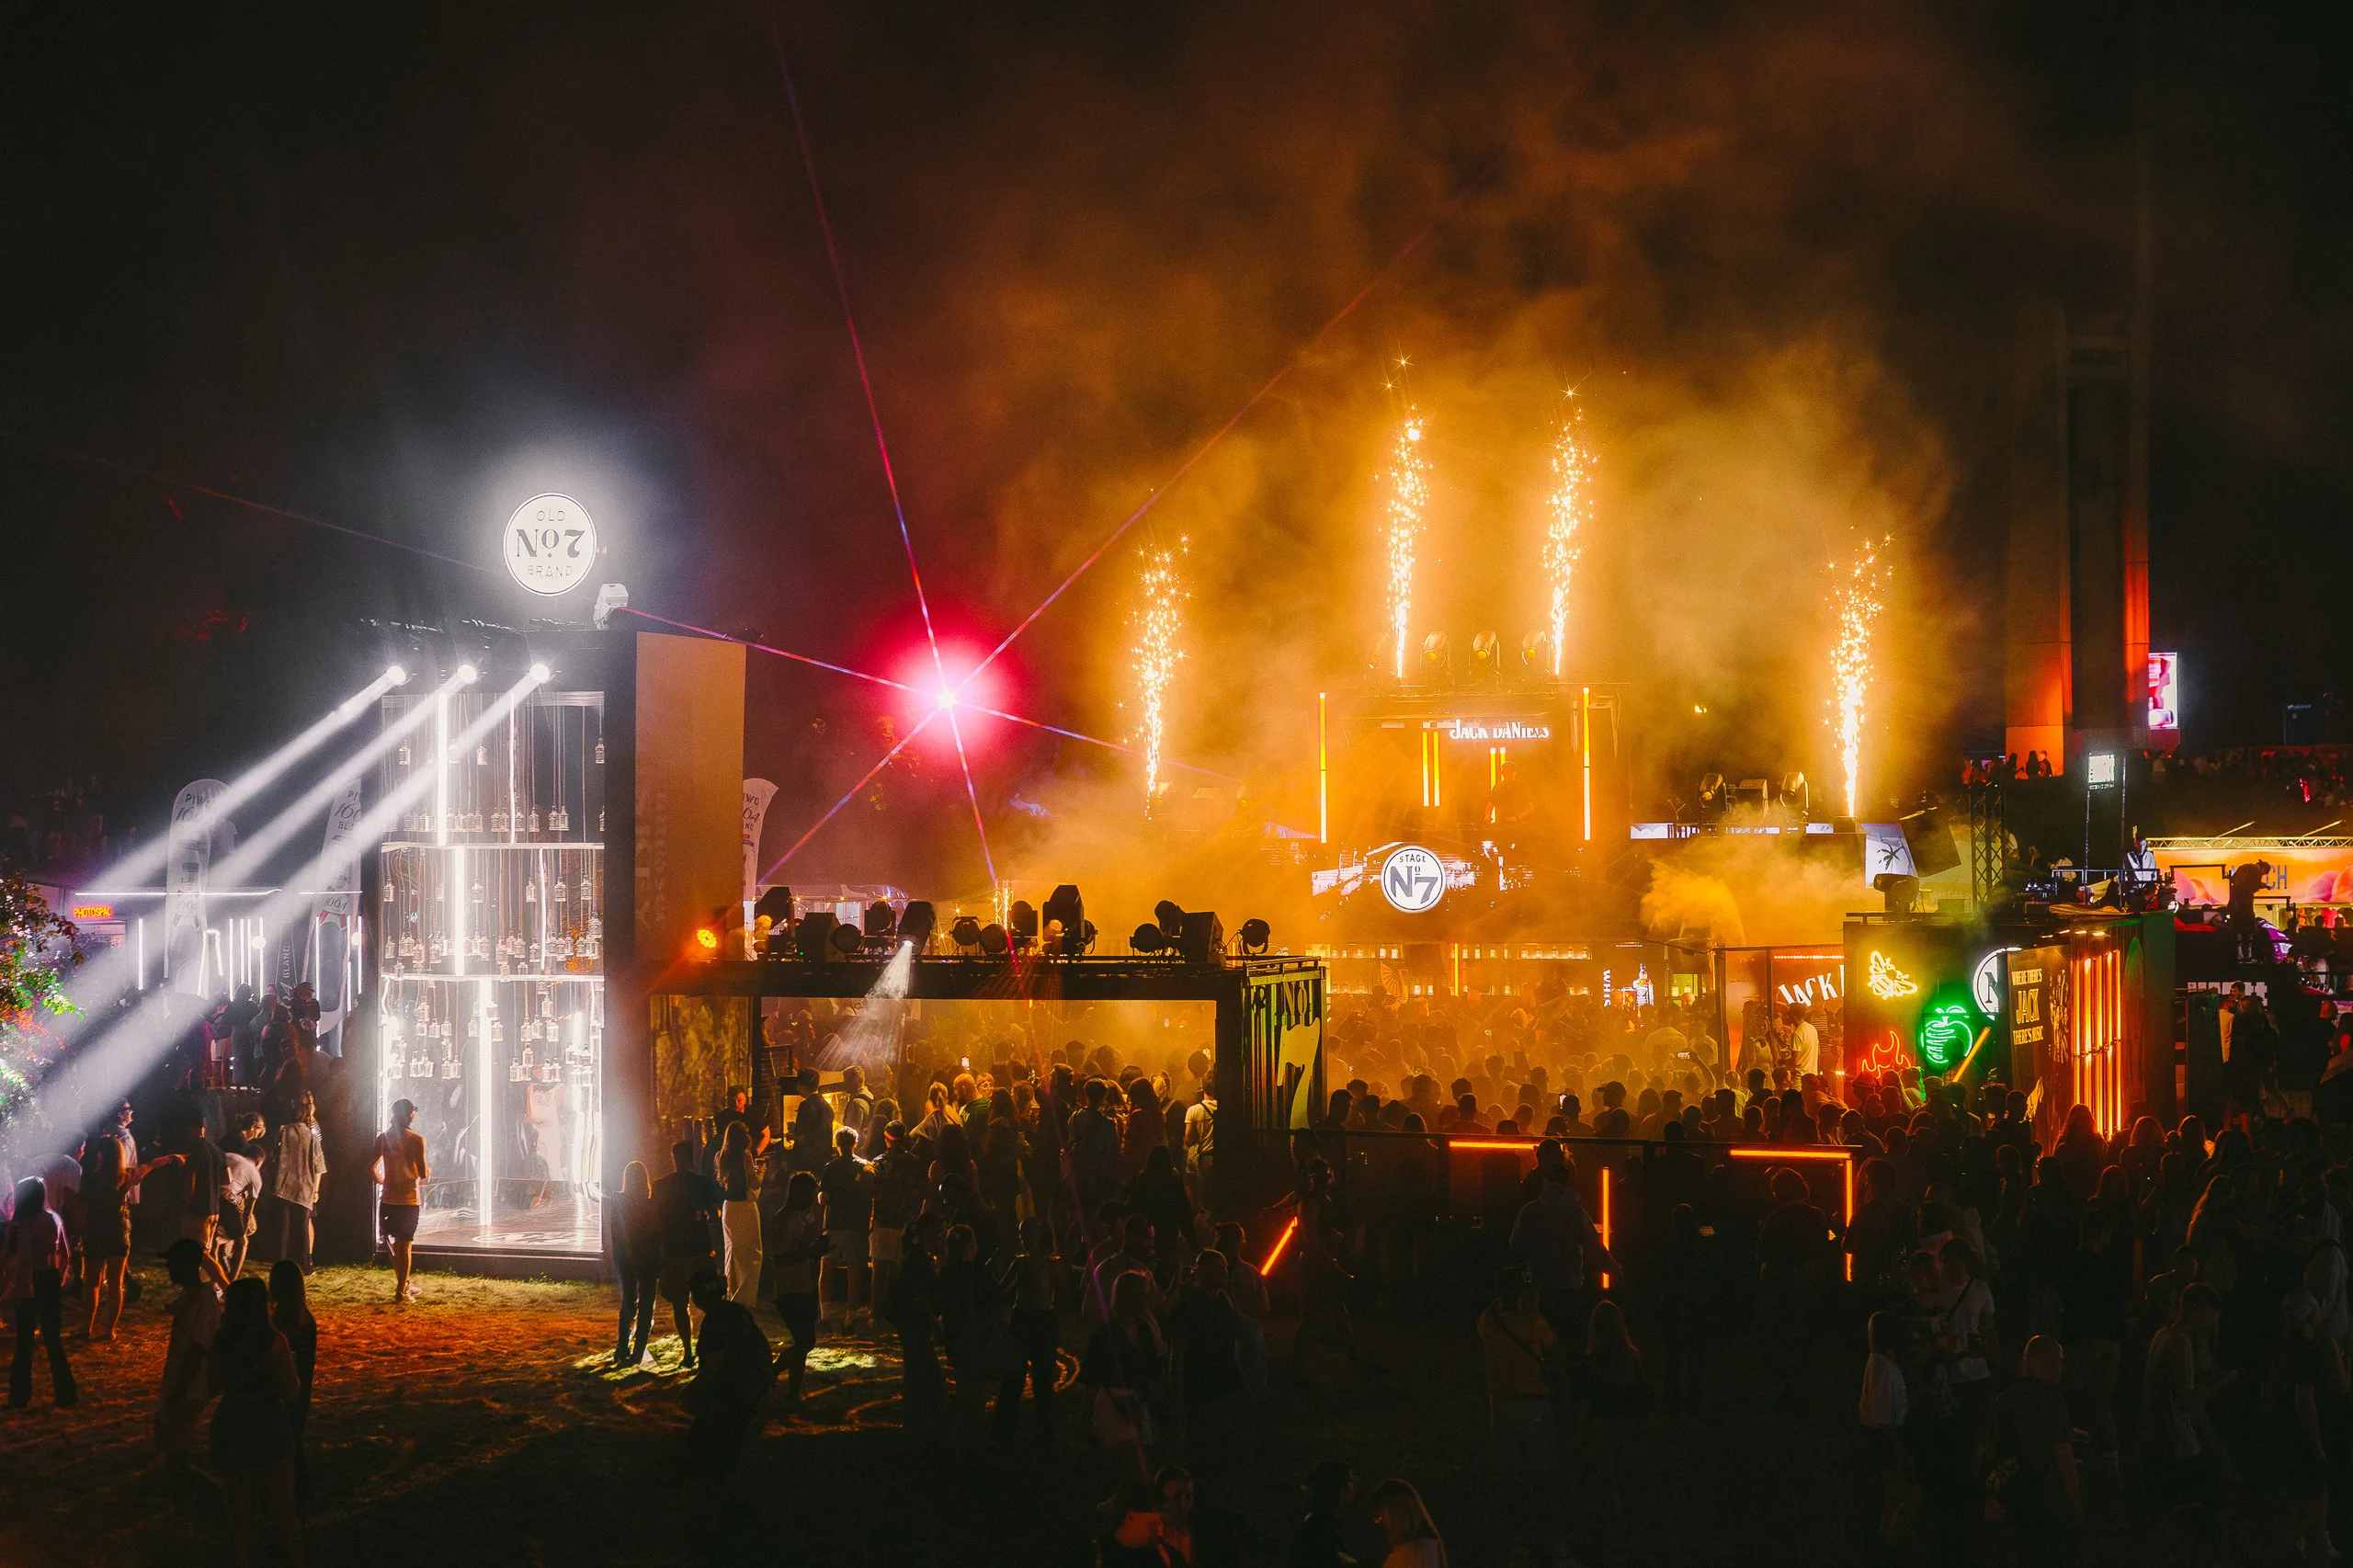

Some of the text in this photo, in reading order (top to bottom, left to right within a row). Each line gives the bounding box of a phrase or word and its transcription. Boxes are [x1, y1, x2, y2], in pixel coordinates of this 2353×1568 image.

[537, 508, 565, 521] OLD
[528, 565, 573, 578] BRAND
[1399, 854, 1427, 863] STAGE
[2016, 987, 2040, 1025] JACK
